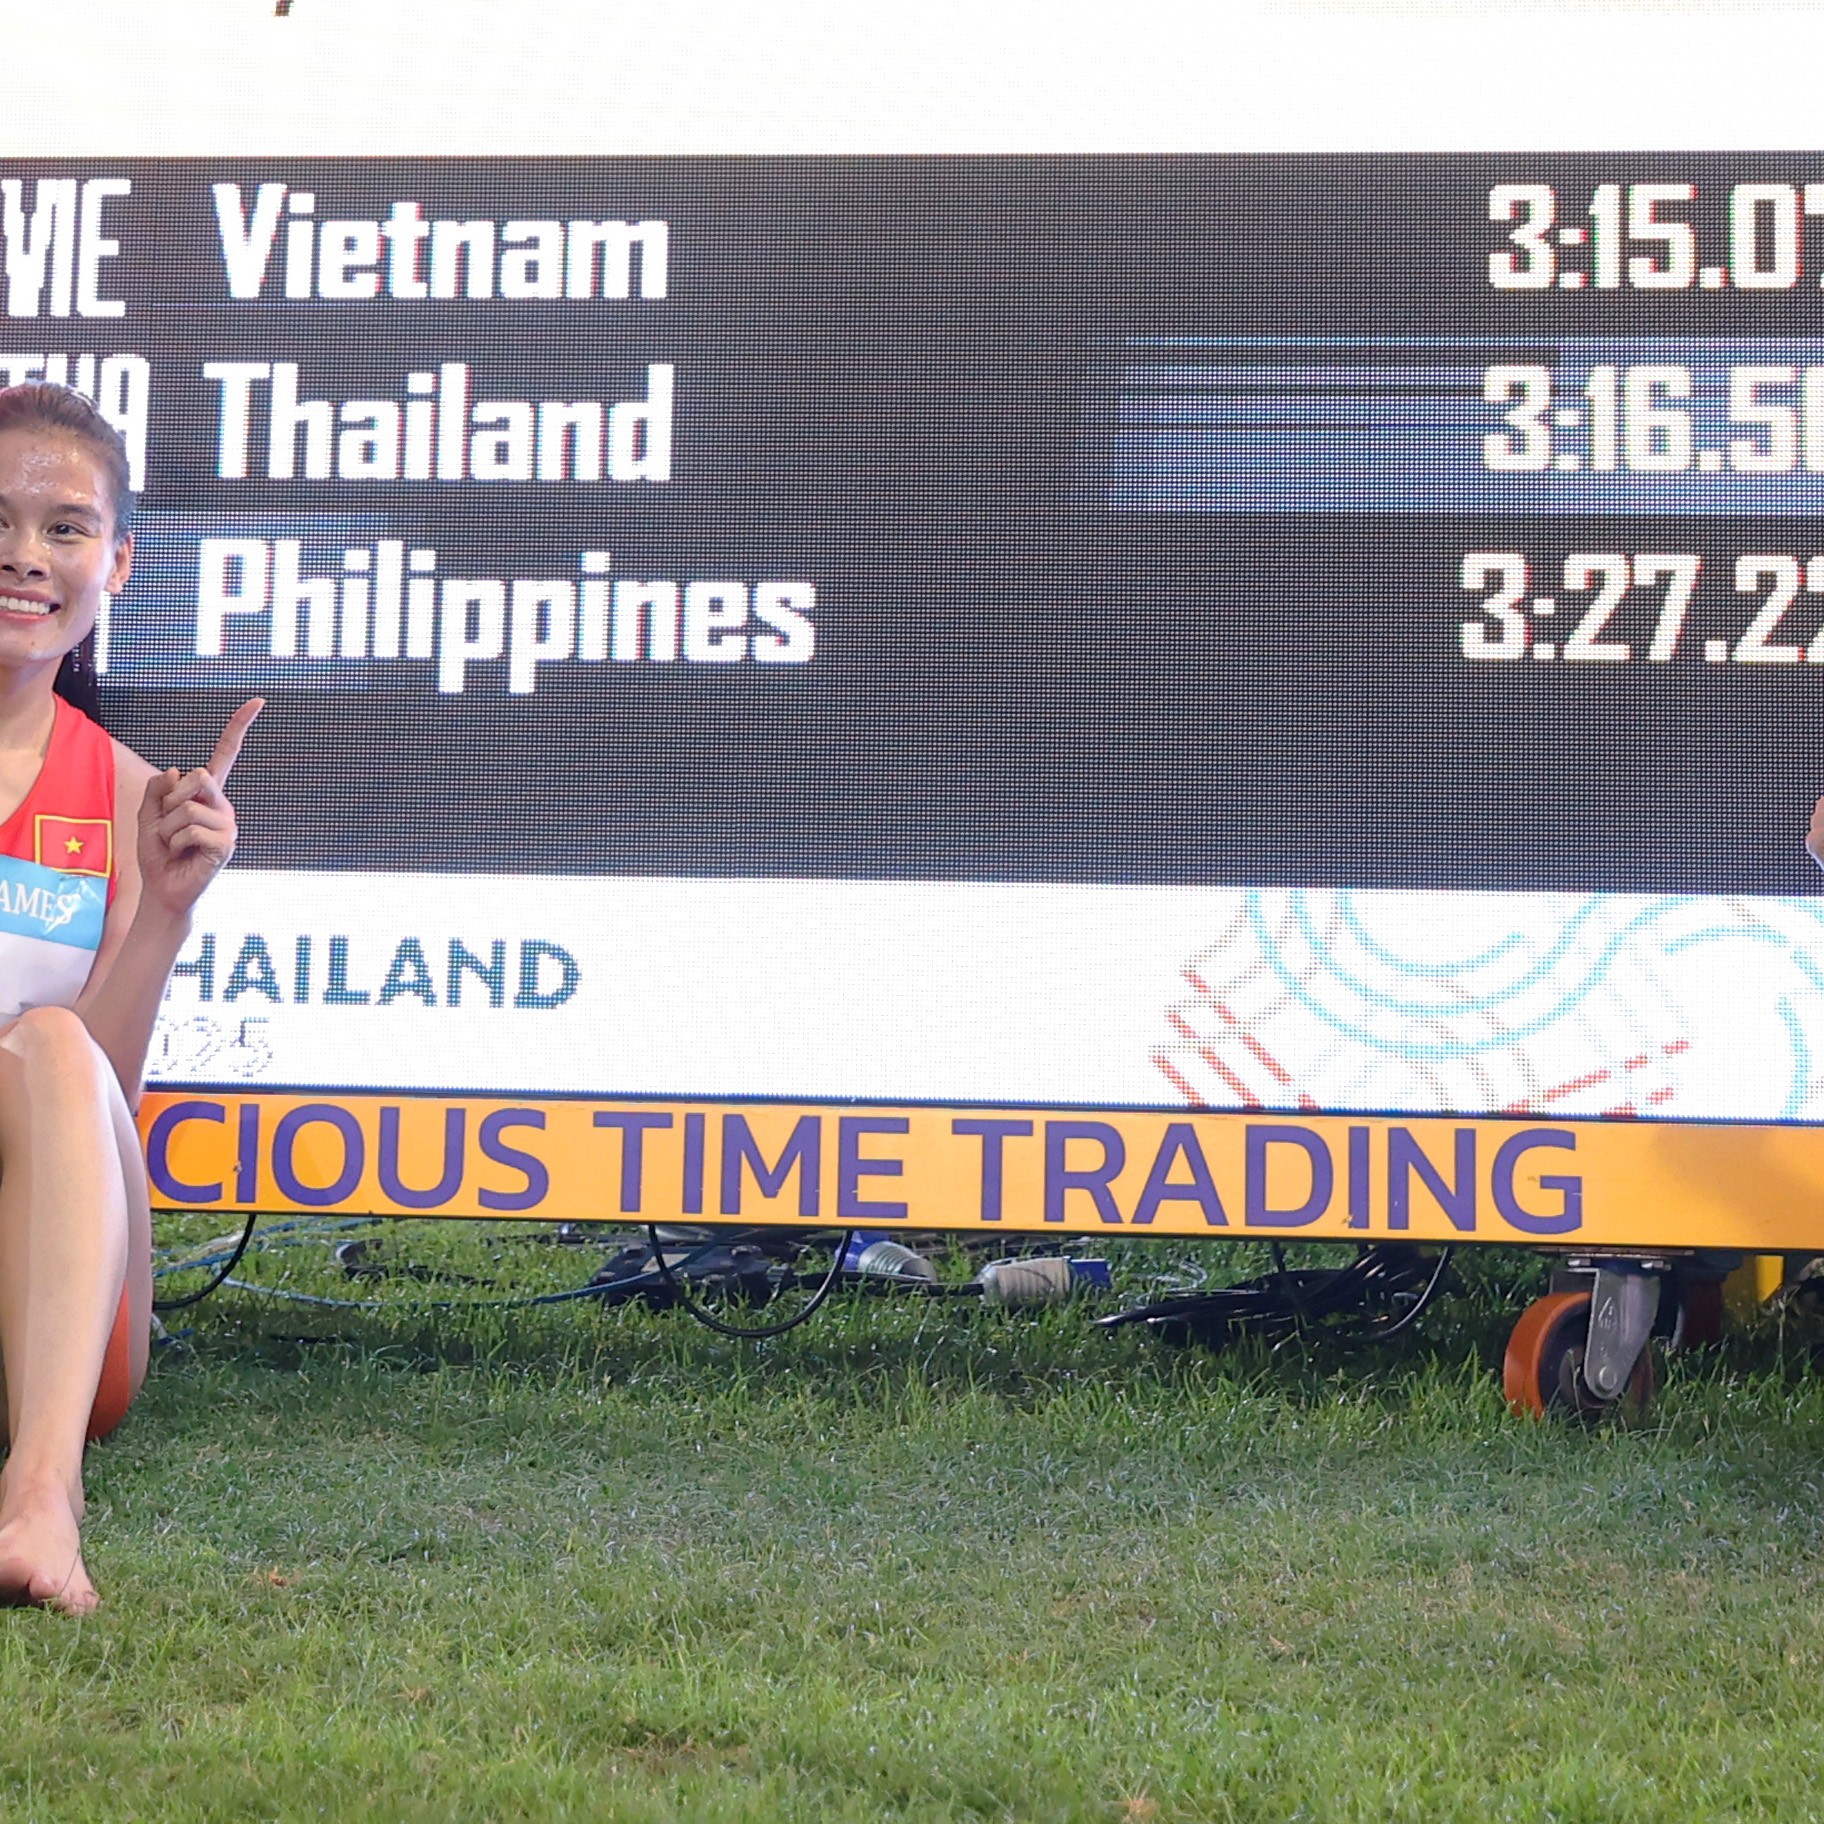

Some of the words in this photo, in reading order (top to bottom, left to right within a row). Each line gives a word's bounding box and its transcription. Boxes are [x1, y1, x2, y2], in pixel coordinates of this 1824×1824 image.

[0, 177, 132, 318] VIE
[210, 183, 670, 300] Vietnam
[201, 360, 676, 483] Thailand
[194, 536, 819, 696] Philippines
[145, 1099, 549, 1212] CIOUS
[592, 1106, 910, 1221] TIME
[952, 1116, 1587, 1236] TRADING
